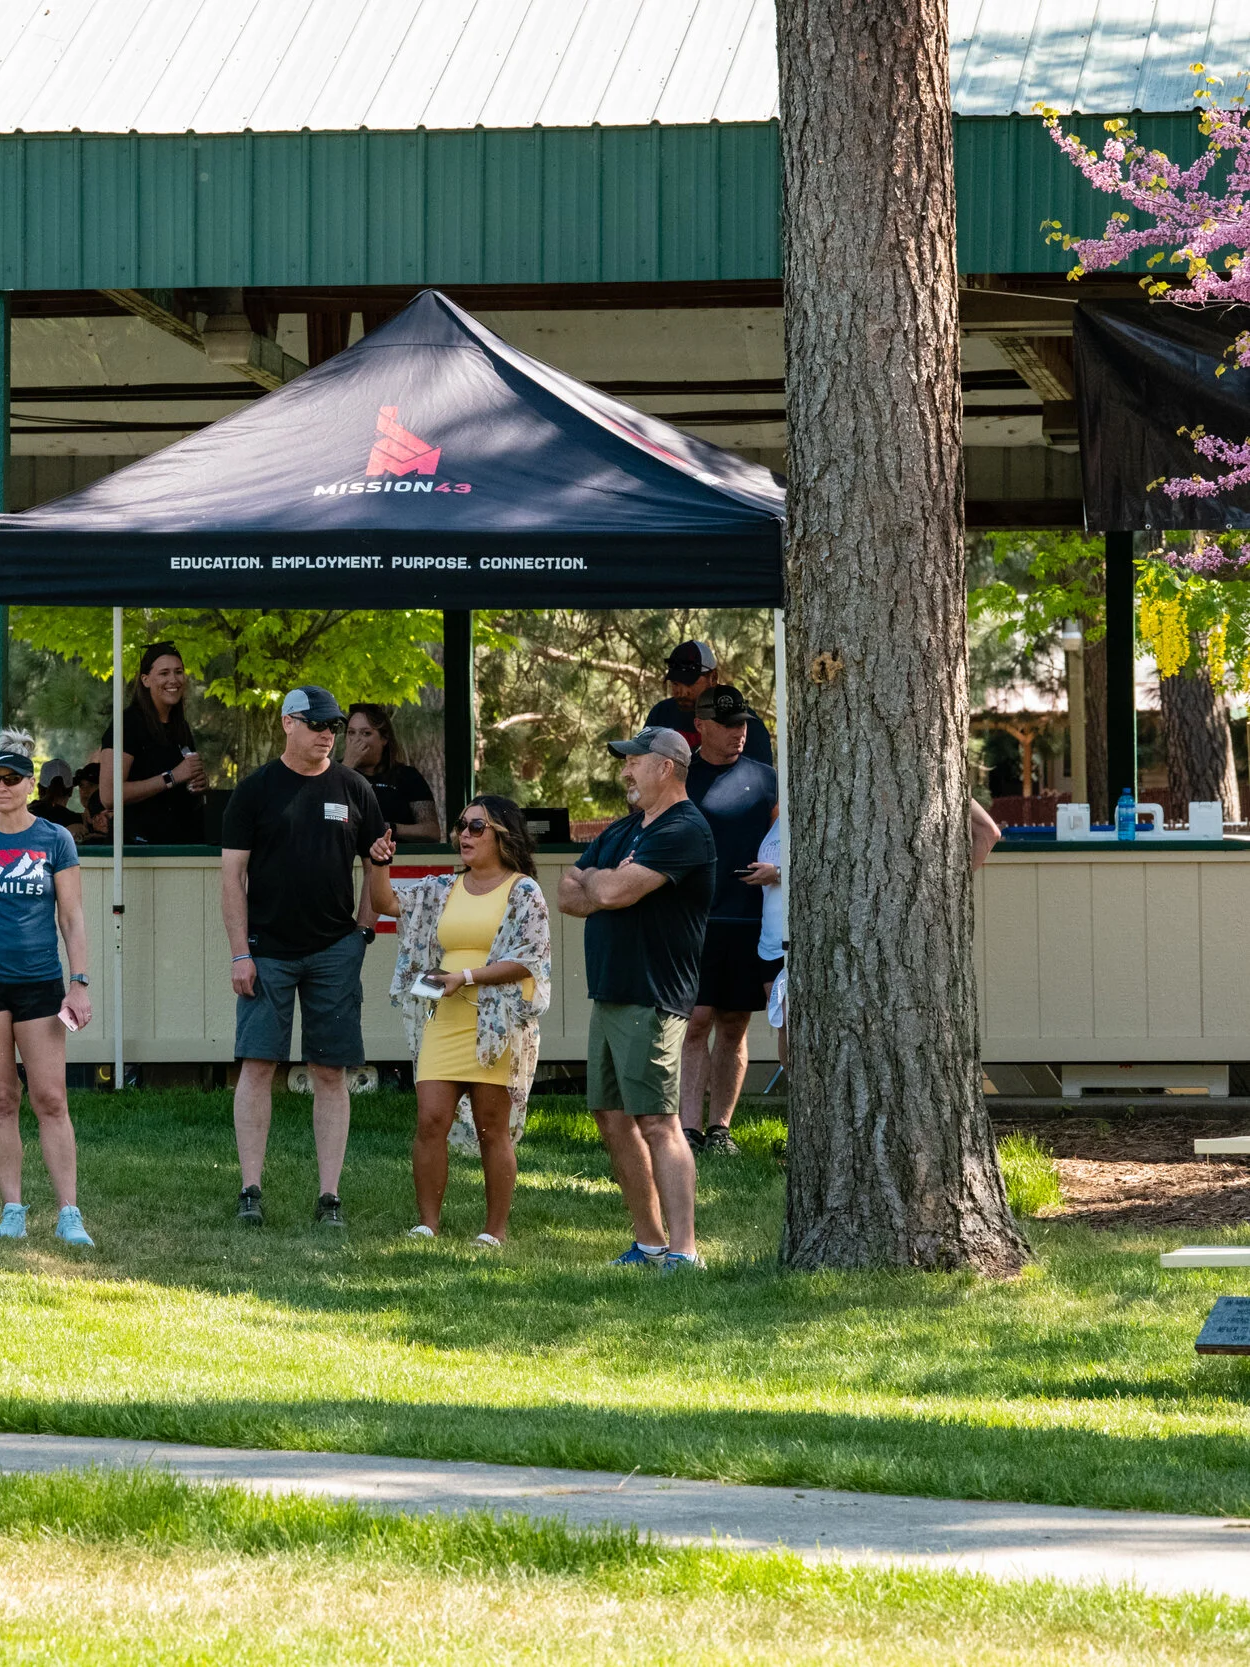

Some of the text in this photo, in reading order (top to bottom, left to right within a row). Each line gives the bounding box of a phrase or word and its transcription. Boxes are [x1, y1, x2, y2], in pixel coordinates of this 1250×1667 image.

[312, 481, 472, 497] MISSION43
[170, 556, 588, 570] EDUCATION. EMPLOYMENT. PURPOSE. CONNECTION.
